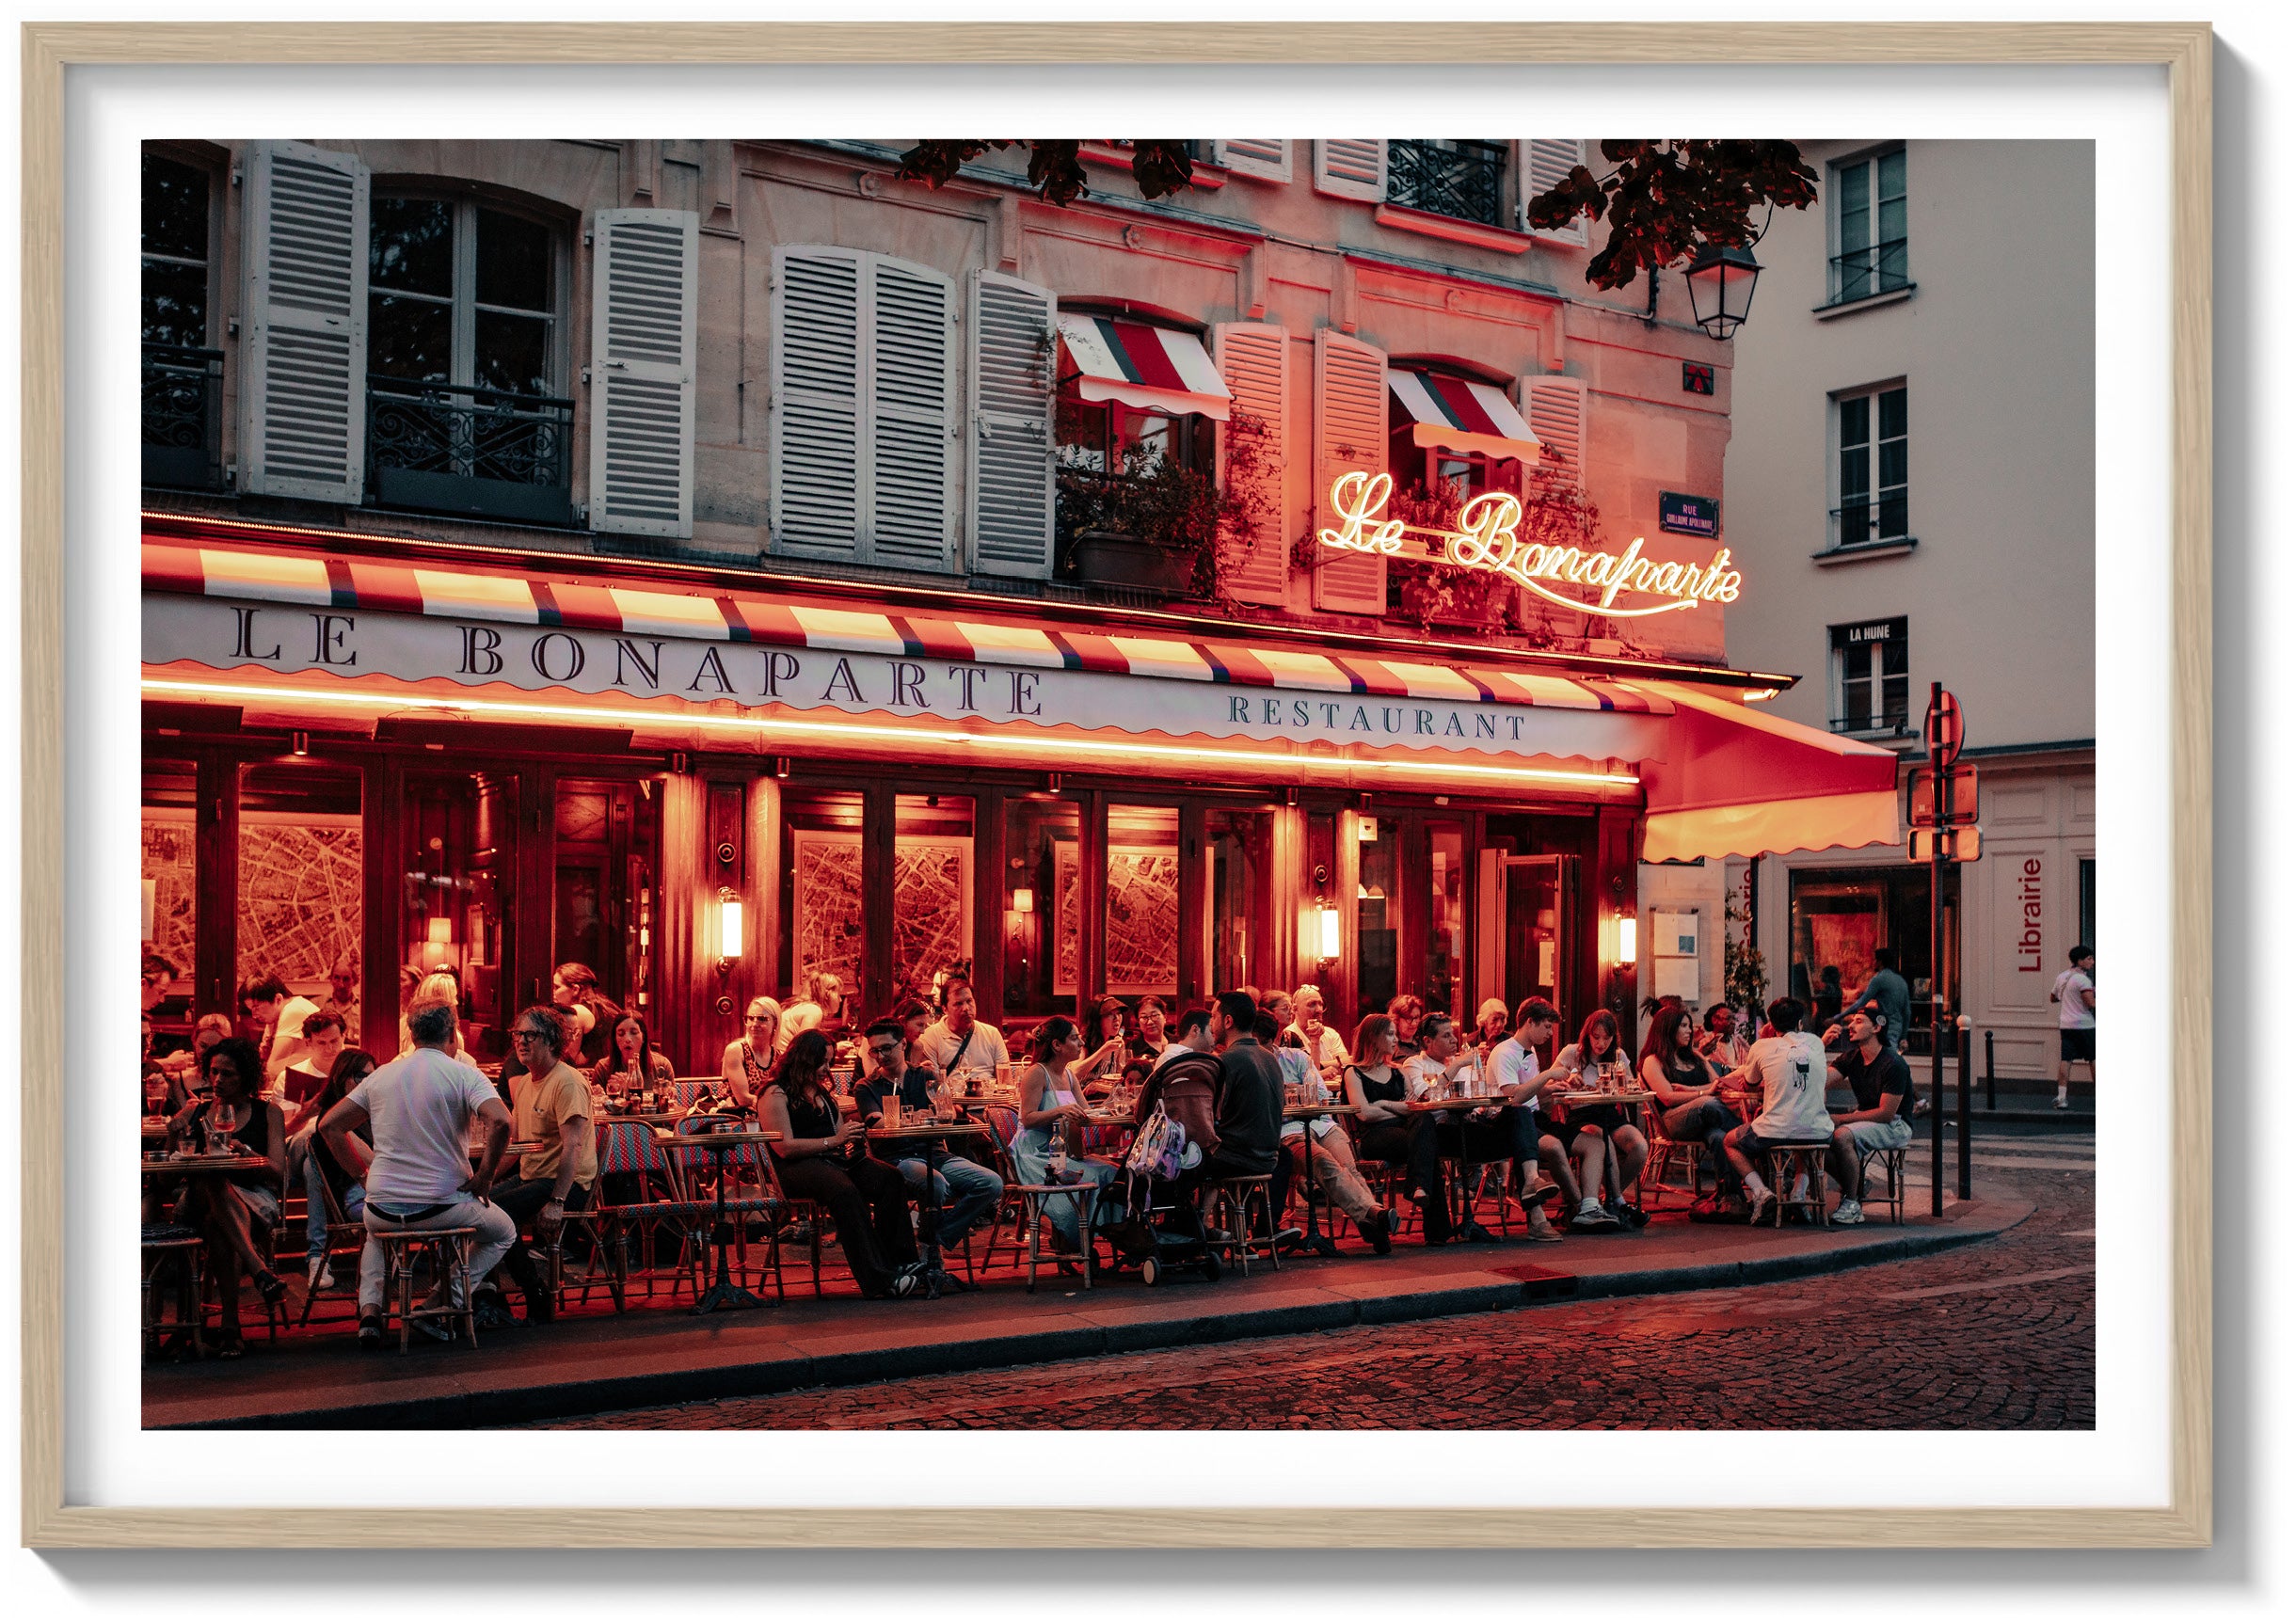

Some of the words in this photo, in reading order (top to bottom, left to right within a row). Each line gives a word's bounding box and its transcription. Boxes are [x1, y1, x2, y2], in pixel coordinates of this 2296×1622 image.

[1317, 471, 1405, 555] Le
[1450, 492, 1742, 618] Bonaparte
[1682, 503, 1698, 517] RUE
[230, 606, 358, 666] LE
[455, 625, 1042, 716] BONAPARTE
[1849, 628, 1862, 642] LA
[1863, 624, 1890, 641] HUNE
[1227, 695, 1525, 741] RESTAURANT
[2017, 858, 2042, 973] Librairie
